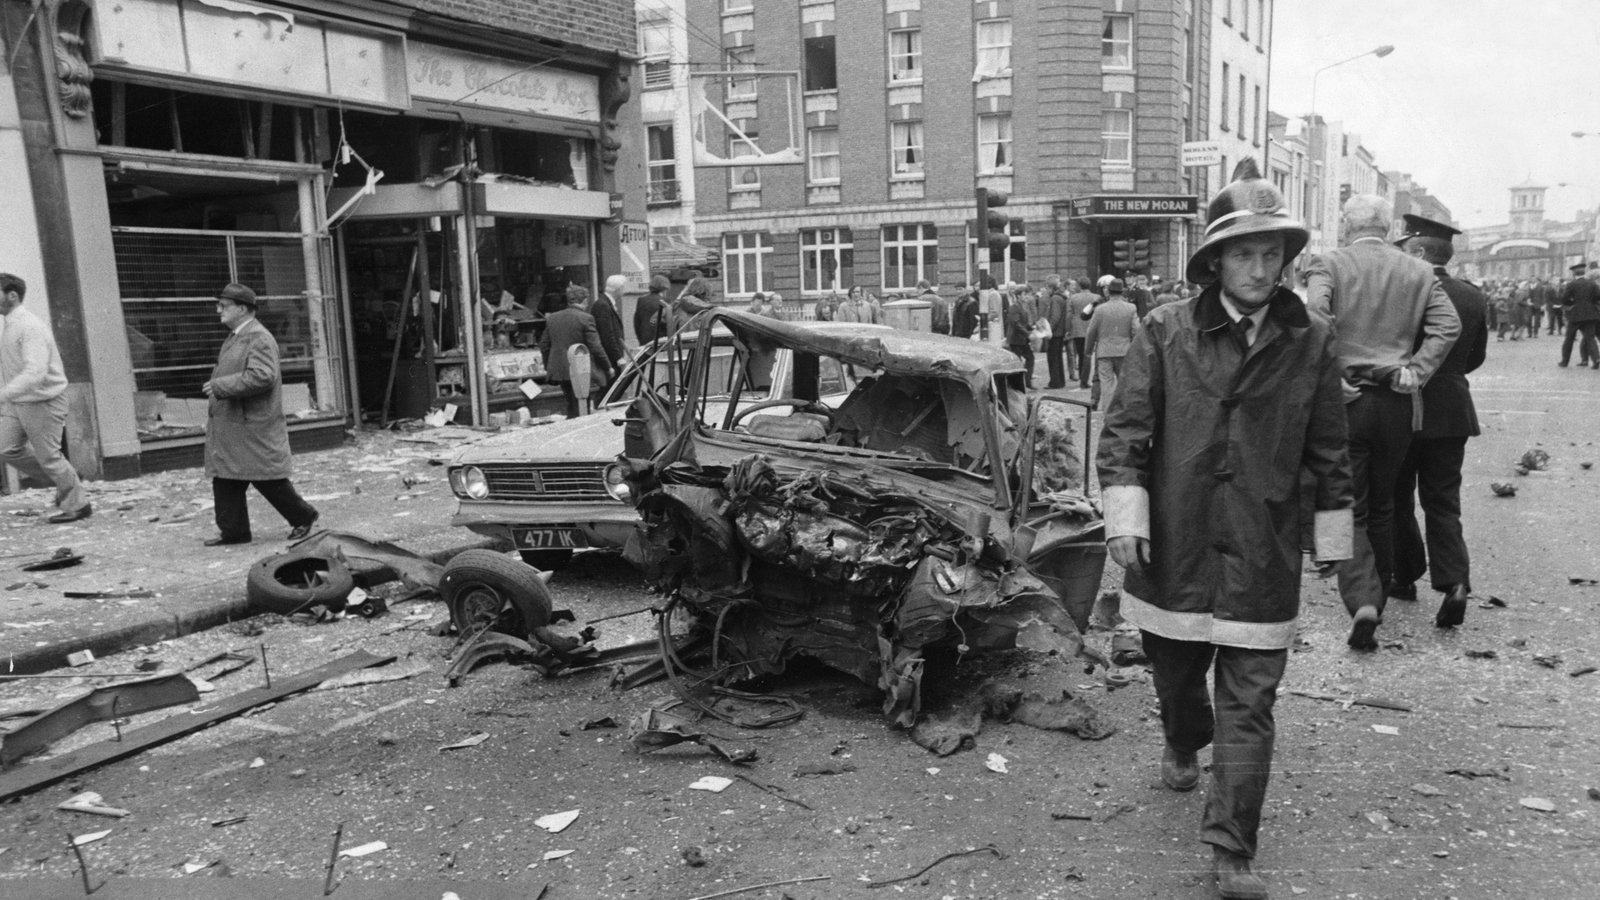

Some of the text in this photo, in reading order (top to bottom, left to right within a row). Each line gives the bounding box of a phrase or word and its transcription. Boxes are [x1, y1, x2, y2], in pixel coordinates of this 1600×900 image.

[413, 54, 452, 87] The
[1103, 200, 1188, 211] THE NEW MORAN
[525, 530, 576, 547] 477 IK
